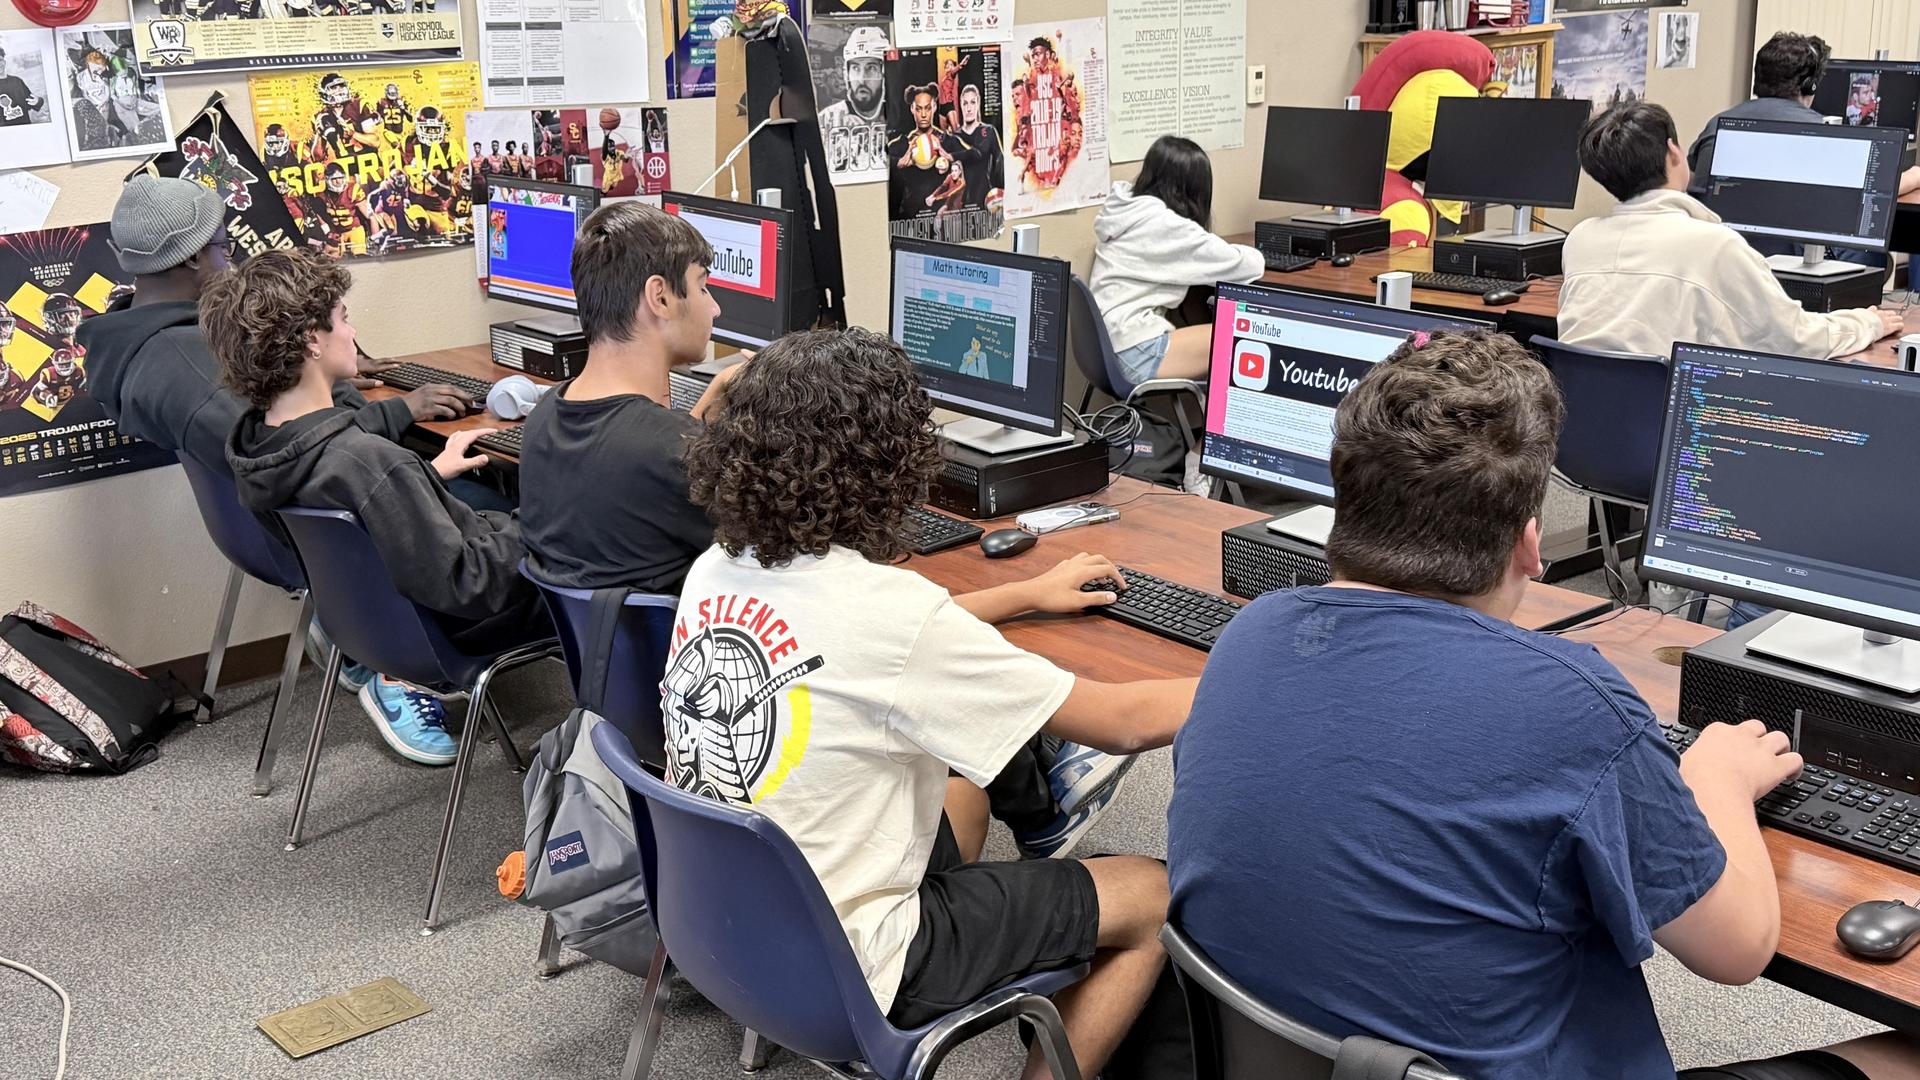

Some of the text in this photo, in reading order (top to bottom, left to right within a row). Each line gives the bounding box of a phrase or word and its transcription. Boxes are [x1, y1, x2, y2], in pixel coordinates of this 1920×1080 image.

[399, 21, 444, 32] HIGH SCHOOL
[400, 30, 456, 41] HOCKEY LEAGUE
[1135, 28, 1179, 42] INTEGRITY
[1183, 26, 1213, 39] VALUE
[1037, 73, 1053, 99] USC
[1122, 87, 1177, 103] EXCELLENCE
[1182, 85, 1210, 97] VISION
[383, 108, 401, 125] 25
[1031, 122, 1061, 150] TROJAN
[712, 246, 753, 277] ouTube
[932, 260, 988, 283] Math tutoring
[1251, 321, 1281, 338] YouTube
[1279, 359, 1360, 393] Youtube
[0, 431, 37, 445] 2025
[38, 423, 88, 438] TROJAN
[698, 594, 799, 665] SILENCE
[549, 841, 584, 866] JANSPORT
